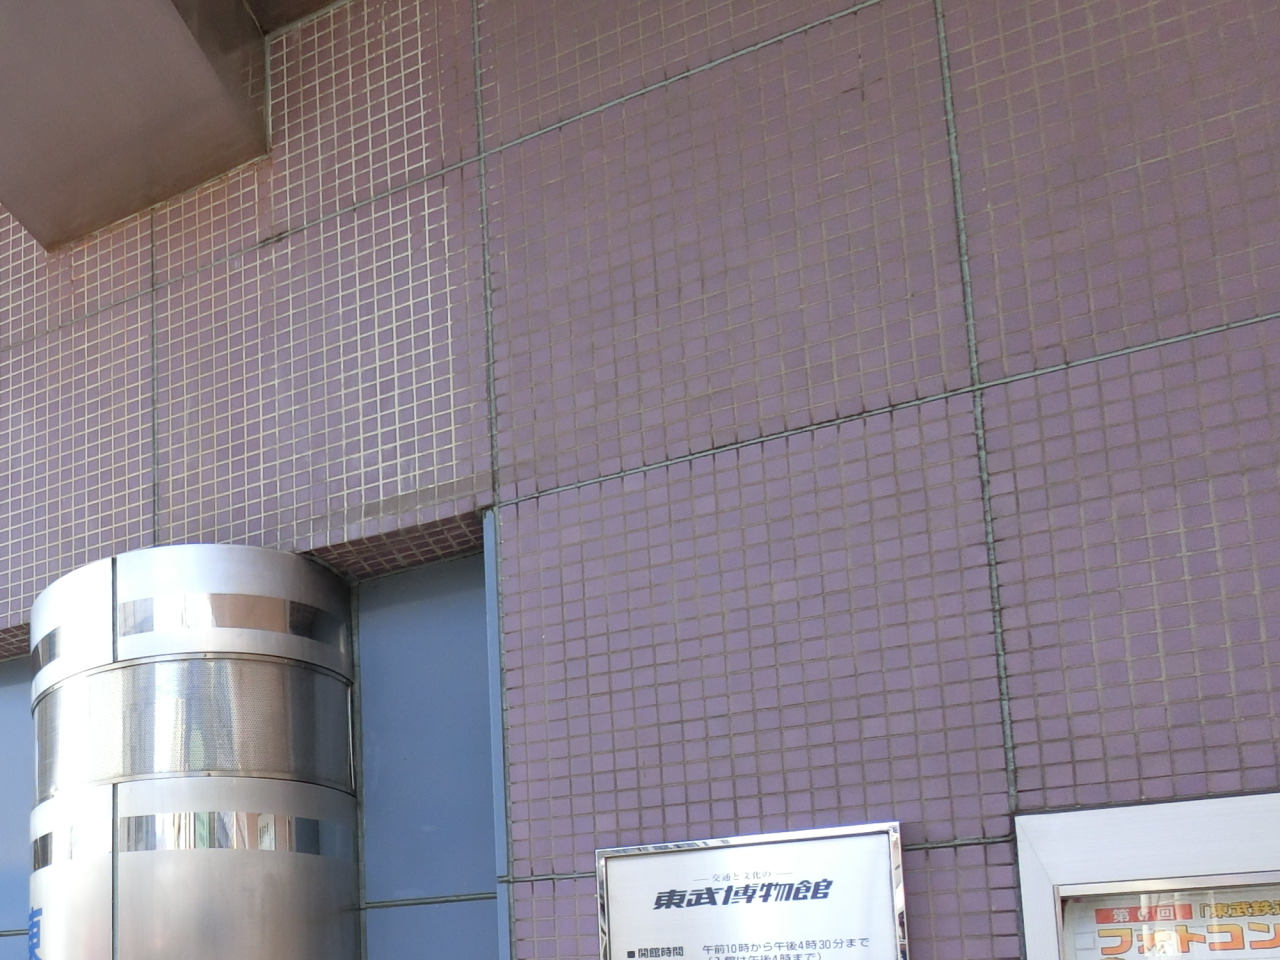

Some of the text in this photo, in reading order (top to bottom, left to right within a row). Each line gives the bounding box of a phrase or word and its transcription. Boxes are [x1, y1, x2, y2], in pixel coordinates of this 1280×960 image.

[653, 878, 833, 910] 東武博物館
[638, 938, 870, 958] 開館時間 午前10時から午後4時30分まで
